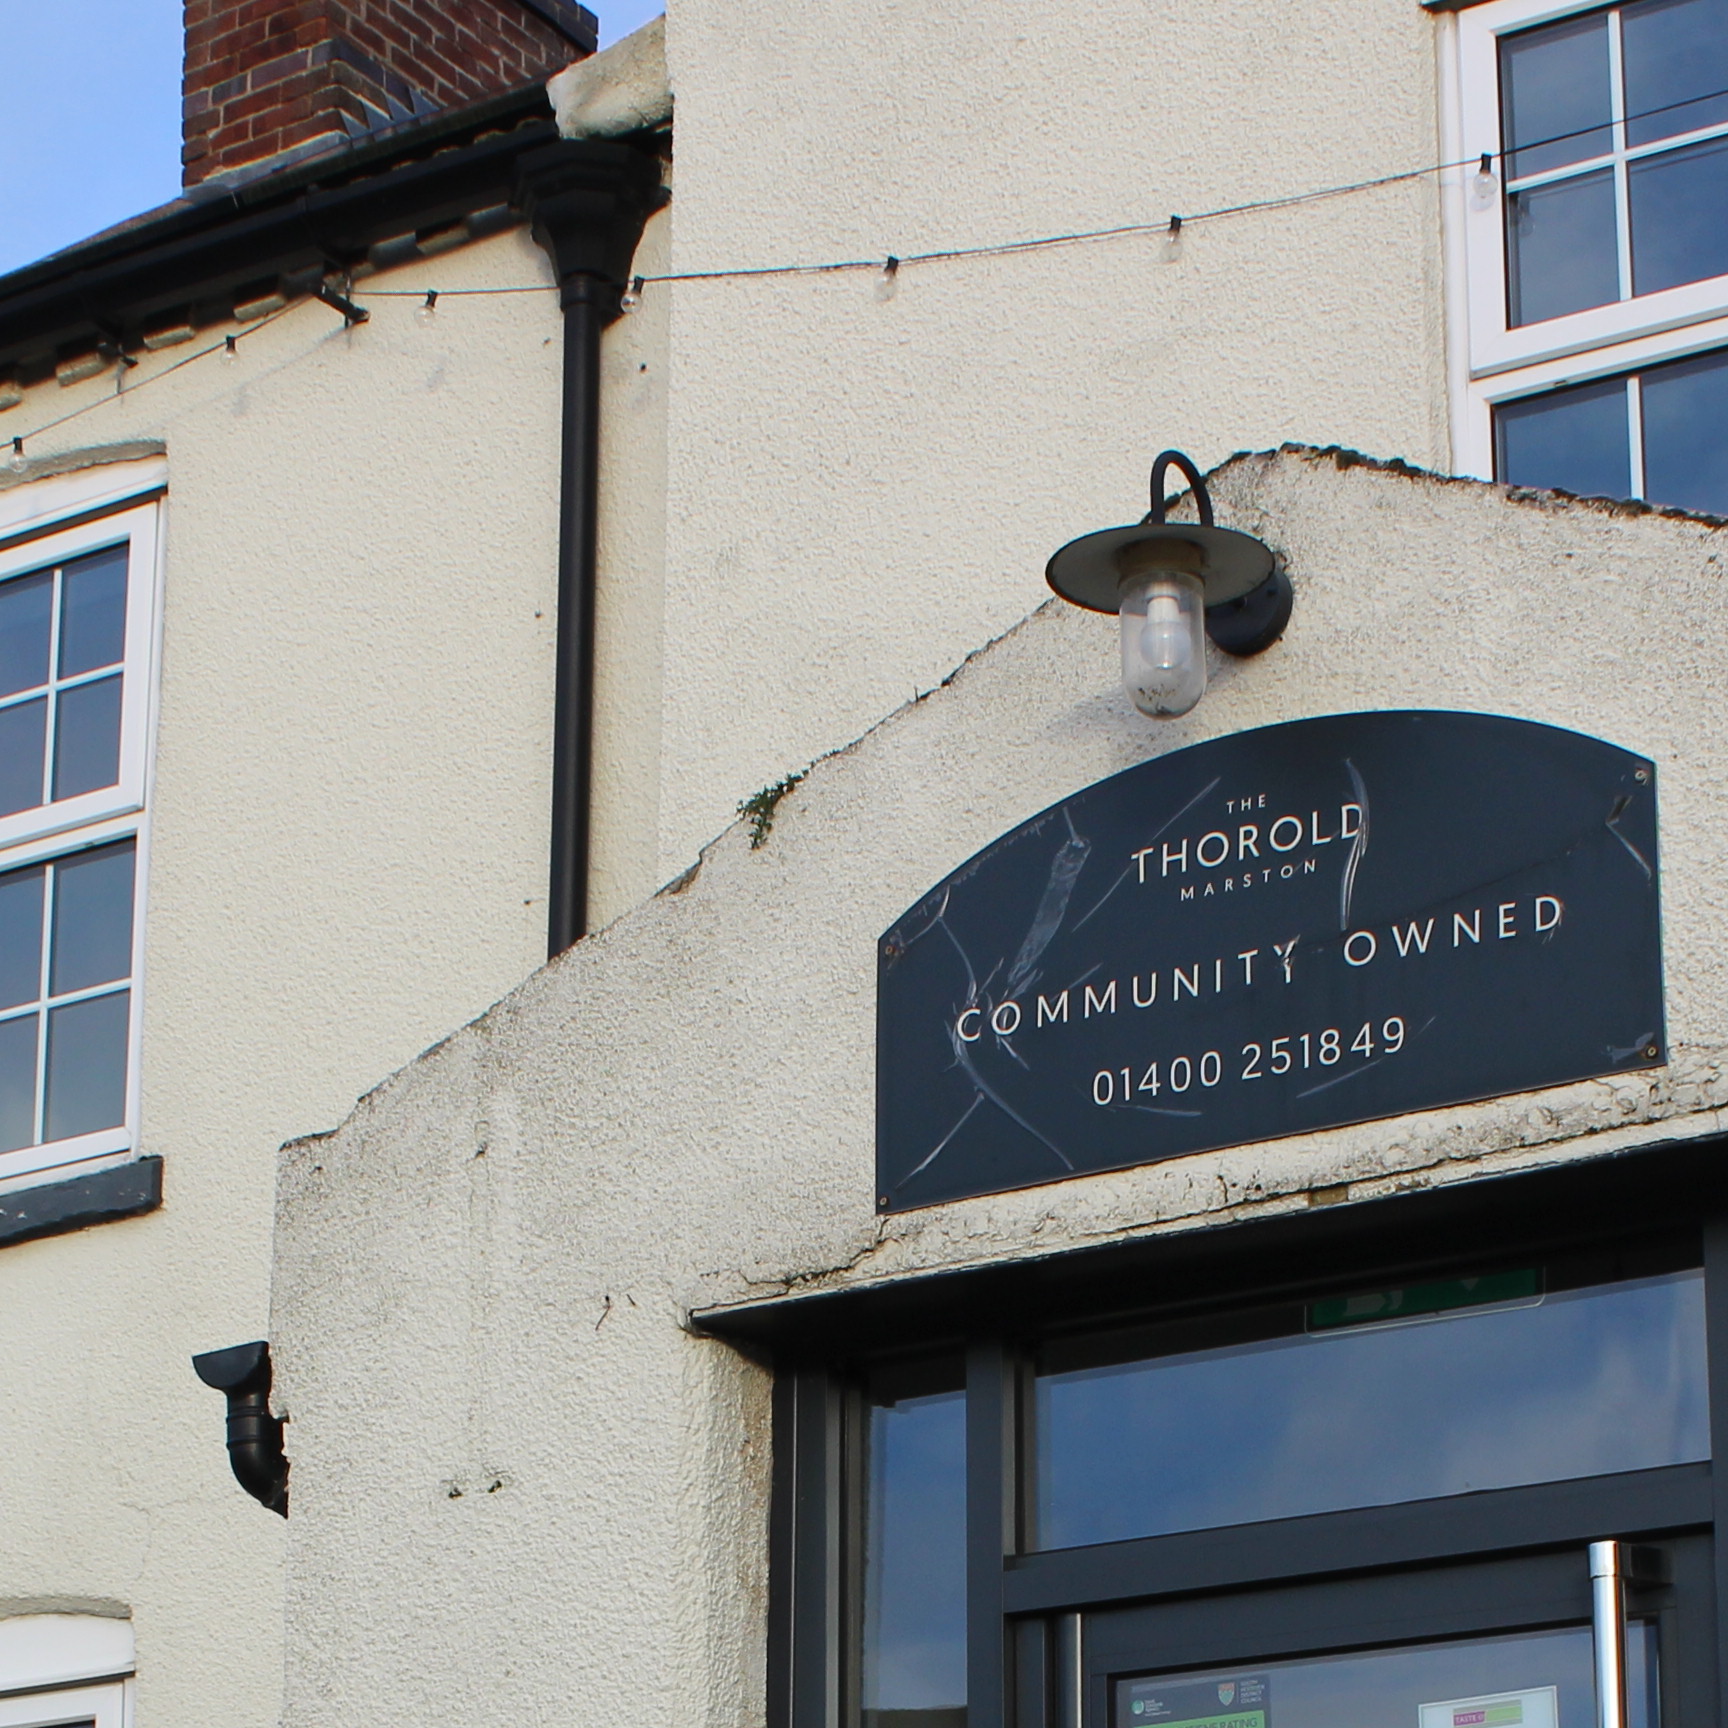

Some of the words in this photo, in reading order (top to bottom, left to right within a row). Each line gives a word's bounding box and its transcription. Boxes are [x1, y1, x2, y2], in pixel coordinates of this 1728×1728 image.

[1132, 803, 1364, 885] THOROLD
[1227, 794, 1266, 813] THE
[1180, 859, 1317, 901] MARSTON
[956, 940, 1299, 1043] COMMUNITY
[1343, 894, 1564, 968] OWNED
[1092, 1050, 1222, 1107] 01400
[1240, 1016, 1406, 1082] 251849
